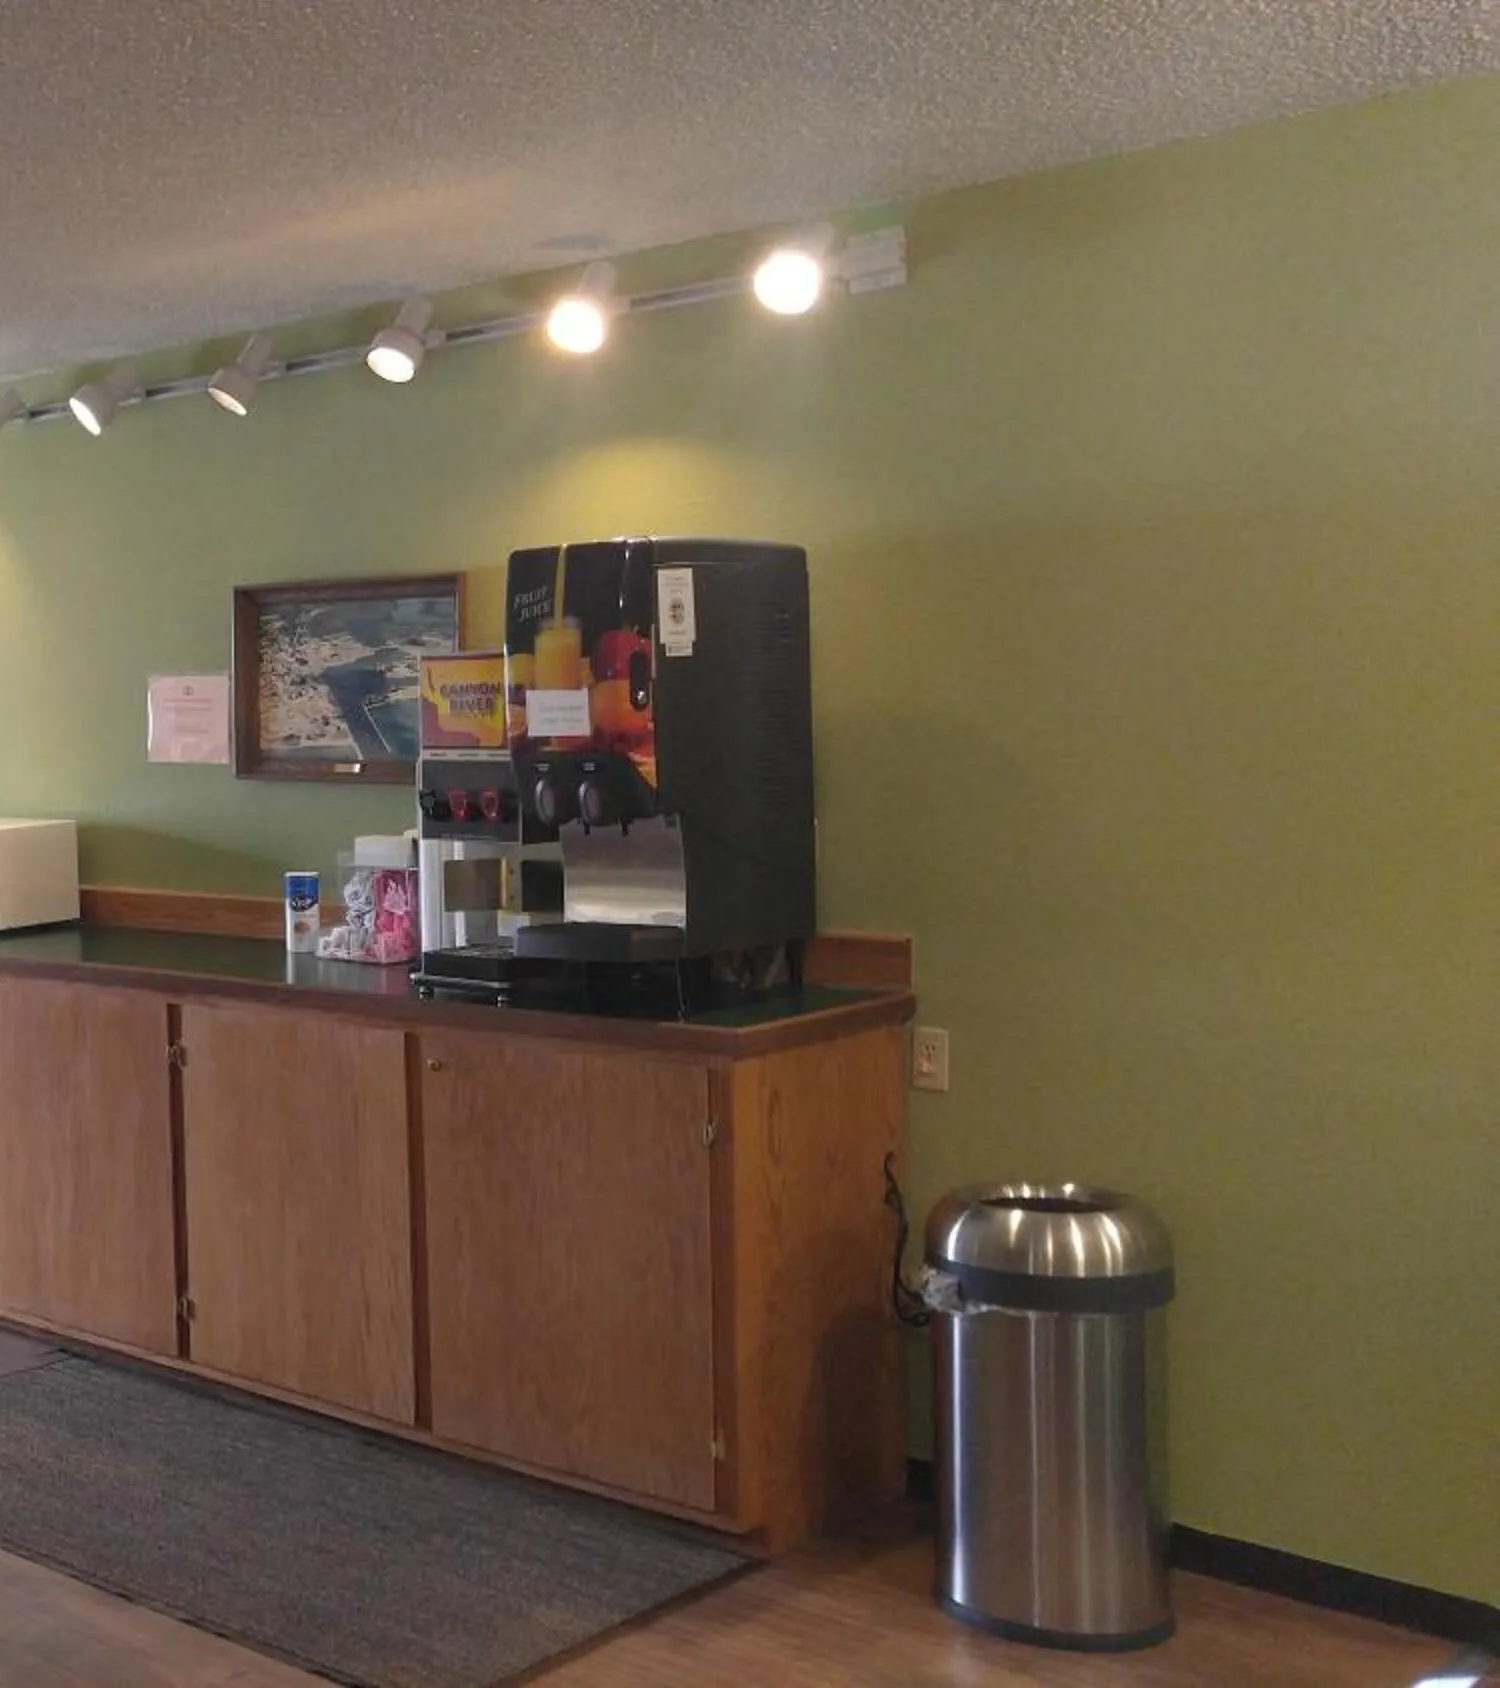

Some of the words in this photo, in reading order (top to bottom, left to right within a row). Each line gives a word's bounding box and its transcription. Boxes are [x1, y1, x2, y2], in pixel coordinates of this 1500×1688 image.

[518, 600, 550, 621] JUICE
[439, 682, 501, 699] CANYON
[449, 698, 494, 714] RIVER
